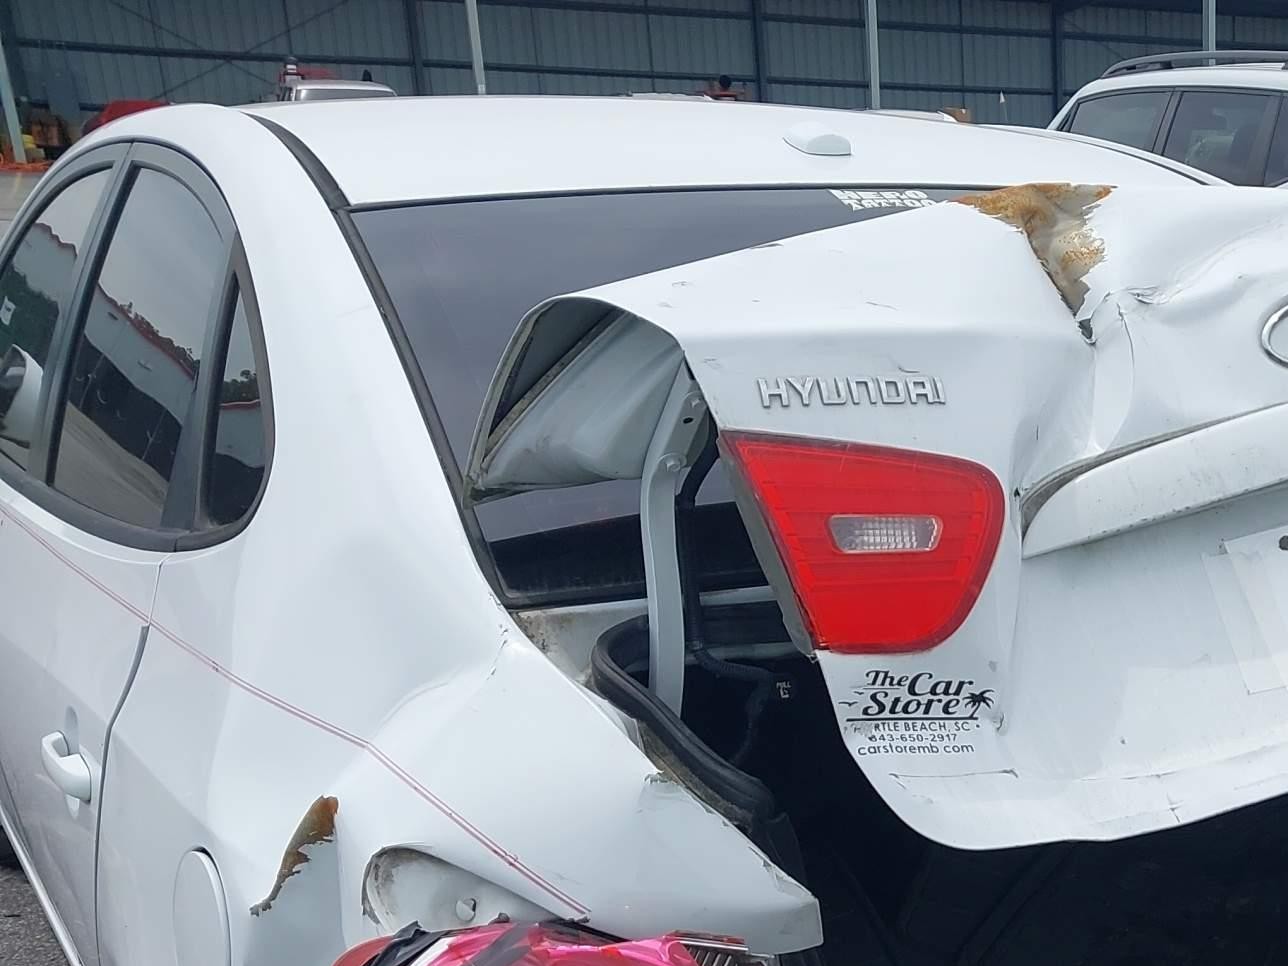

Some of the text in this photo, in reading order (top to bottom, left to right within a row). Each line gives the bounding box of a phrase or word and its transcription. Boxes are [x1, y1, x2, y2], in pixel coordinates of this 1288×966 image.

[756, 375, 946, 409] HYUNDAI
[865, 670, 974, 697] The Car
[862, 691, 961, 716] Store
[954, 721, 971, 732] SC
[857, 743, 975, 756] carstorembcom
